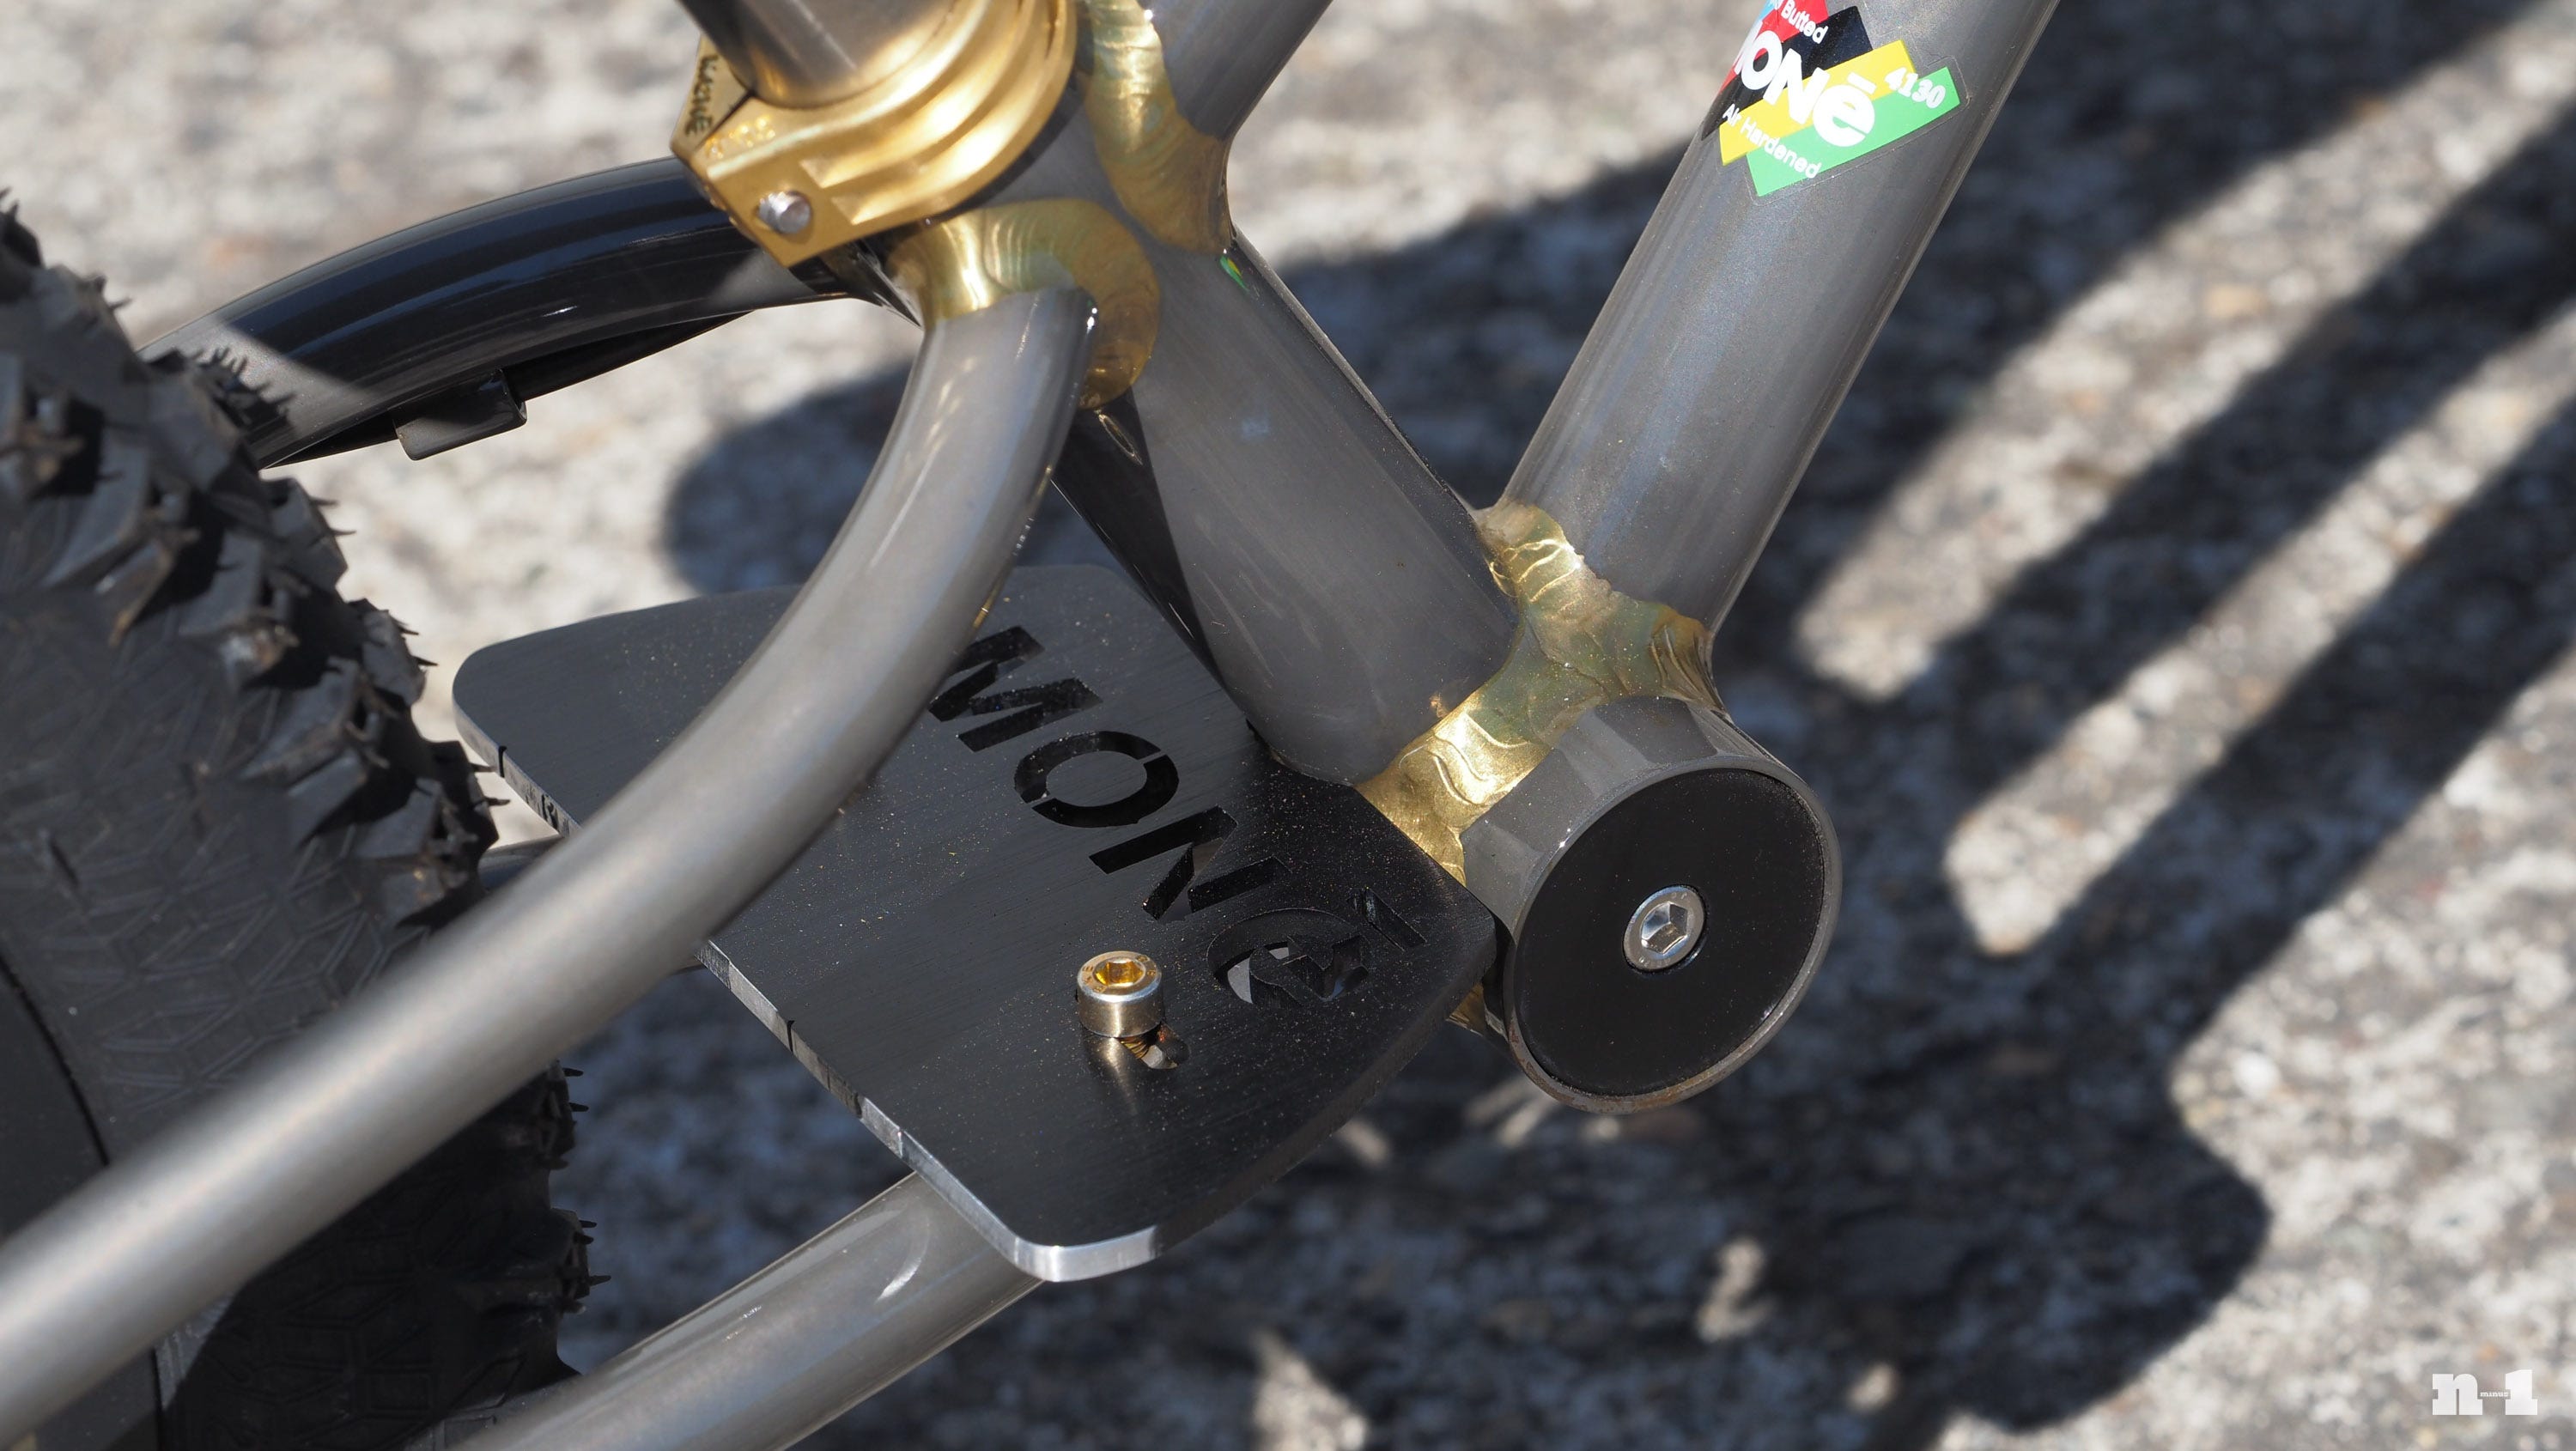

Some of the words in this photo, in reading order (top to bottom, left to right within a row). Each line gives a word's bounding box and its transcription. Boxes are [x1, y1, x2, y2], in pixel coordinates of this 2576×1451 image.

[1781, 0, 1828, 44] Butted
[1884, 67, 1946, 108] 4130
[1740, 116, 1822, 179] Hardened
